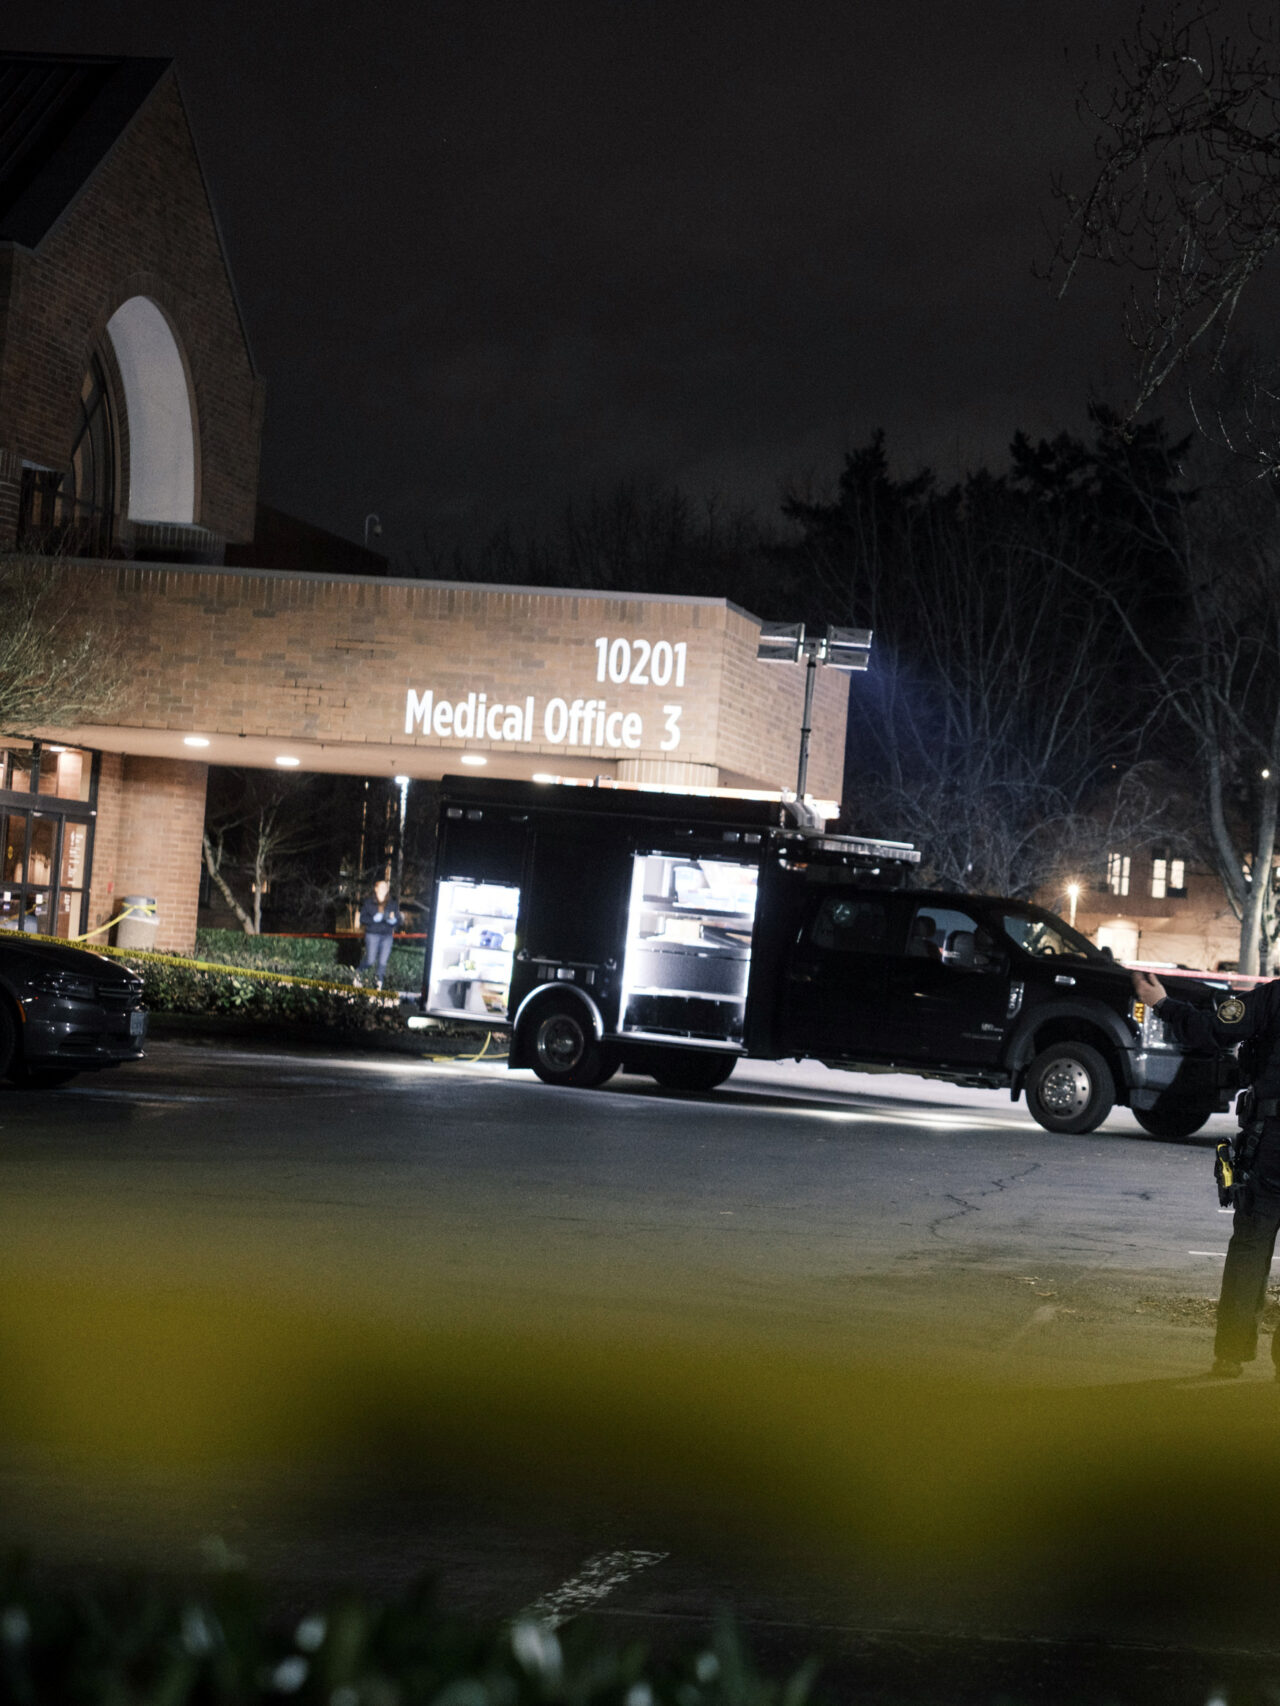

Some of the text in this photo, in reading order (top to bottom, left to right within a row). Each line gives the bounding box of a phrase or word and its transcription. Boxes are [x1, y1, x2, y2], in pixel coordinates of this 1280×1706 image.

[595, 637, 687, 687] 10201
[404, 689, 683, 750] Medical Office 3
[94, 945, 113, 954] POLICE
